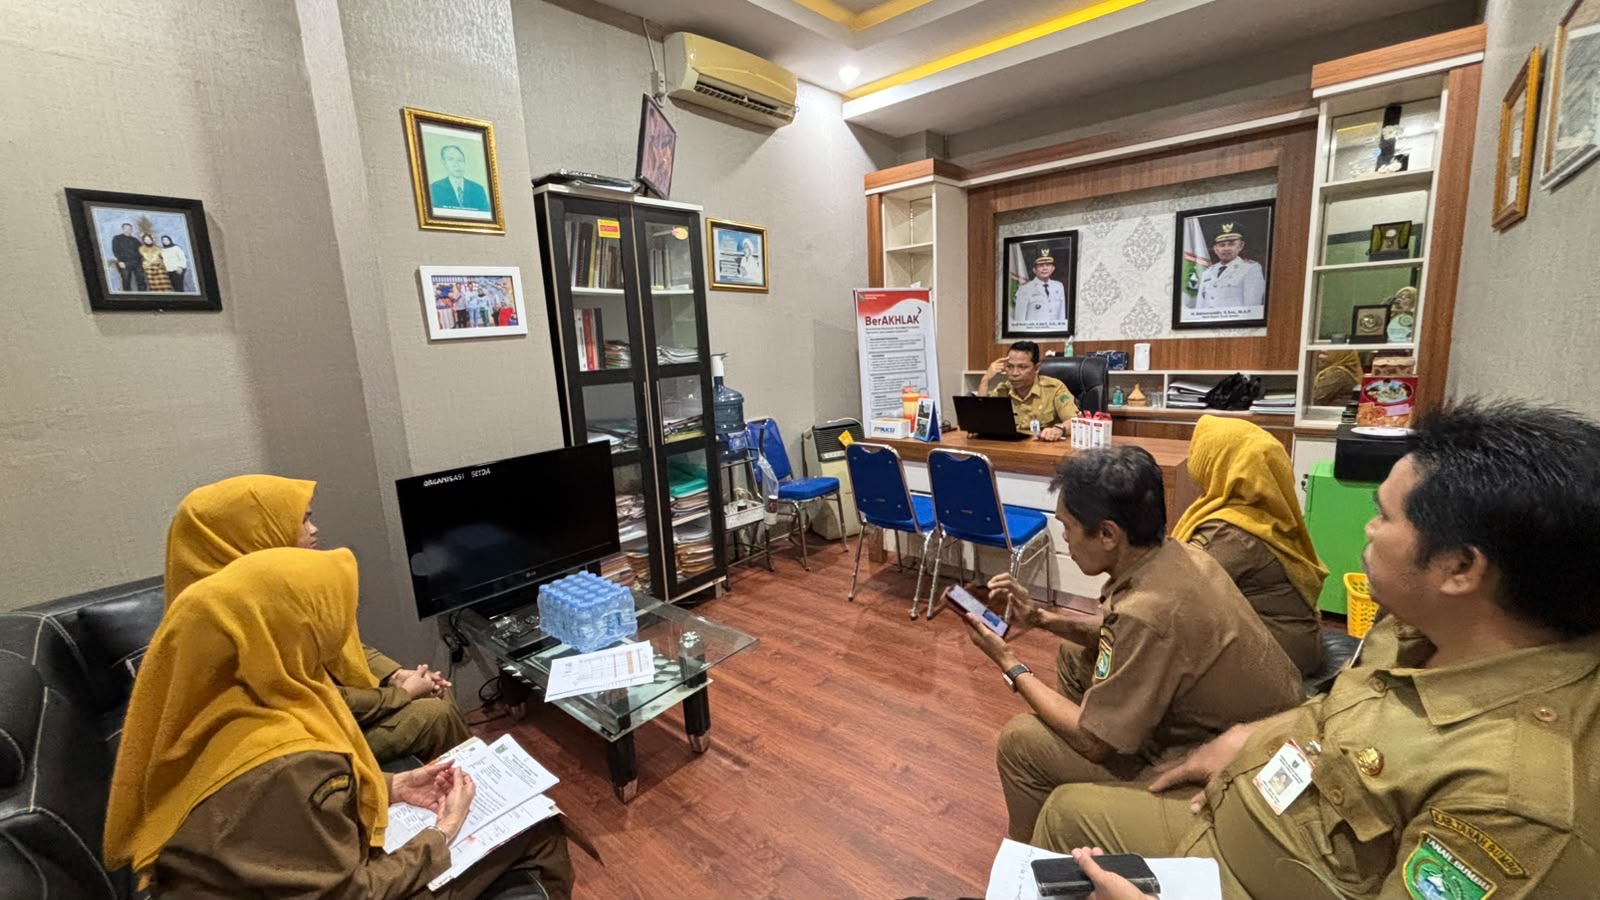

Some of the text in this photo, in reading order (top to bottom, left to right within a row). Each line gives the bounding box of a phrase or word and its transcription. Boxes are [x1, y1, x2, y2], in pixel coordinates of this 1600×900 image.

[865, 315, 919, 326] BerAKHLAK
[423, 473, 465, 487] ORGANISASI
[1453, 860, 1491, 891] BUMBU
